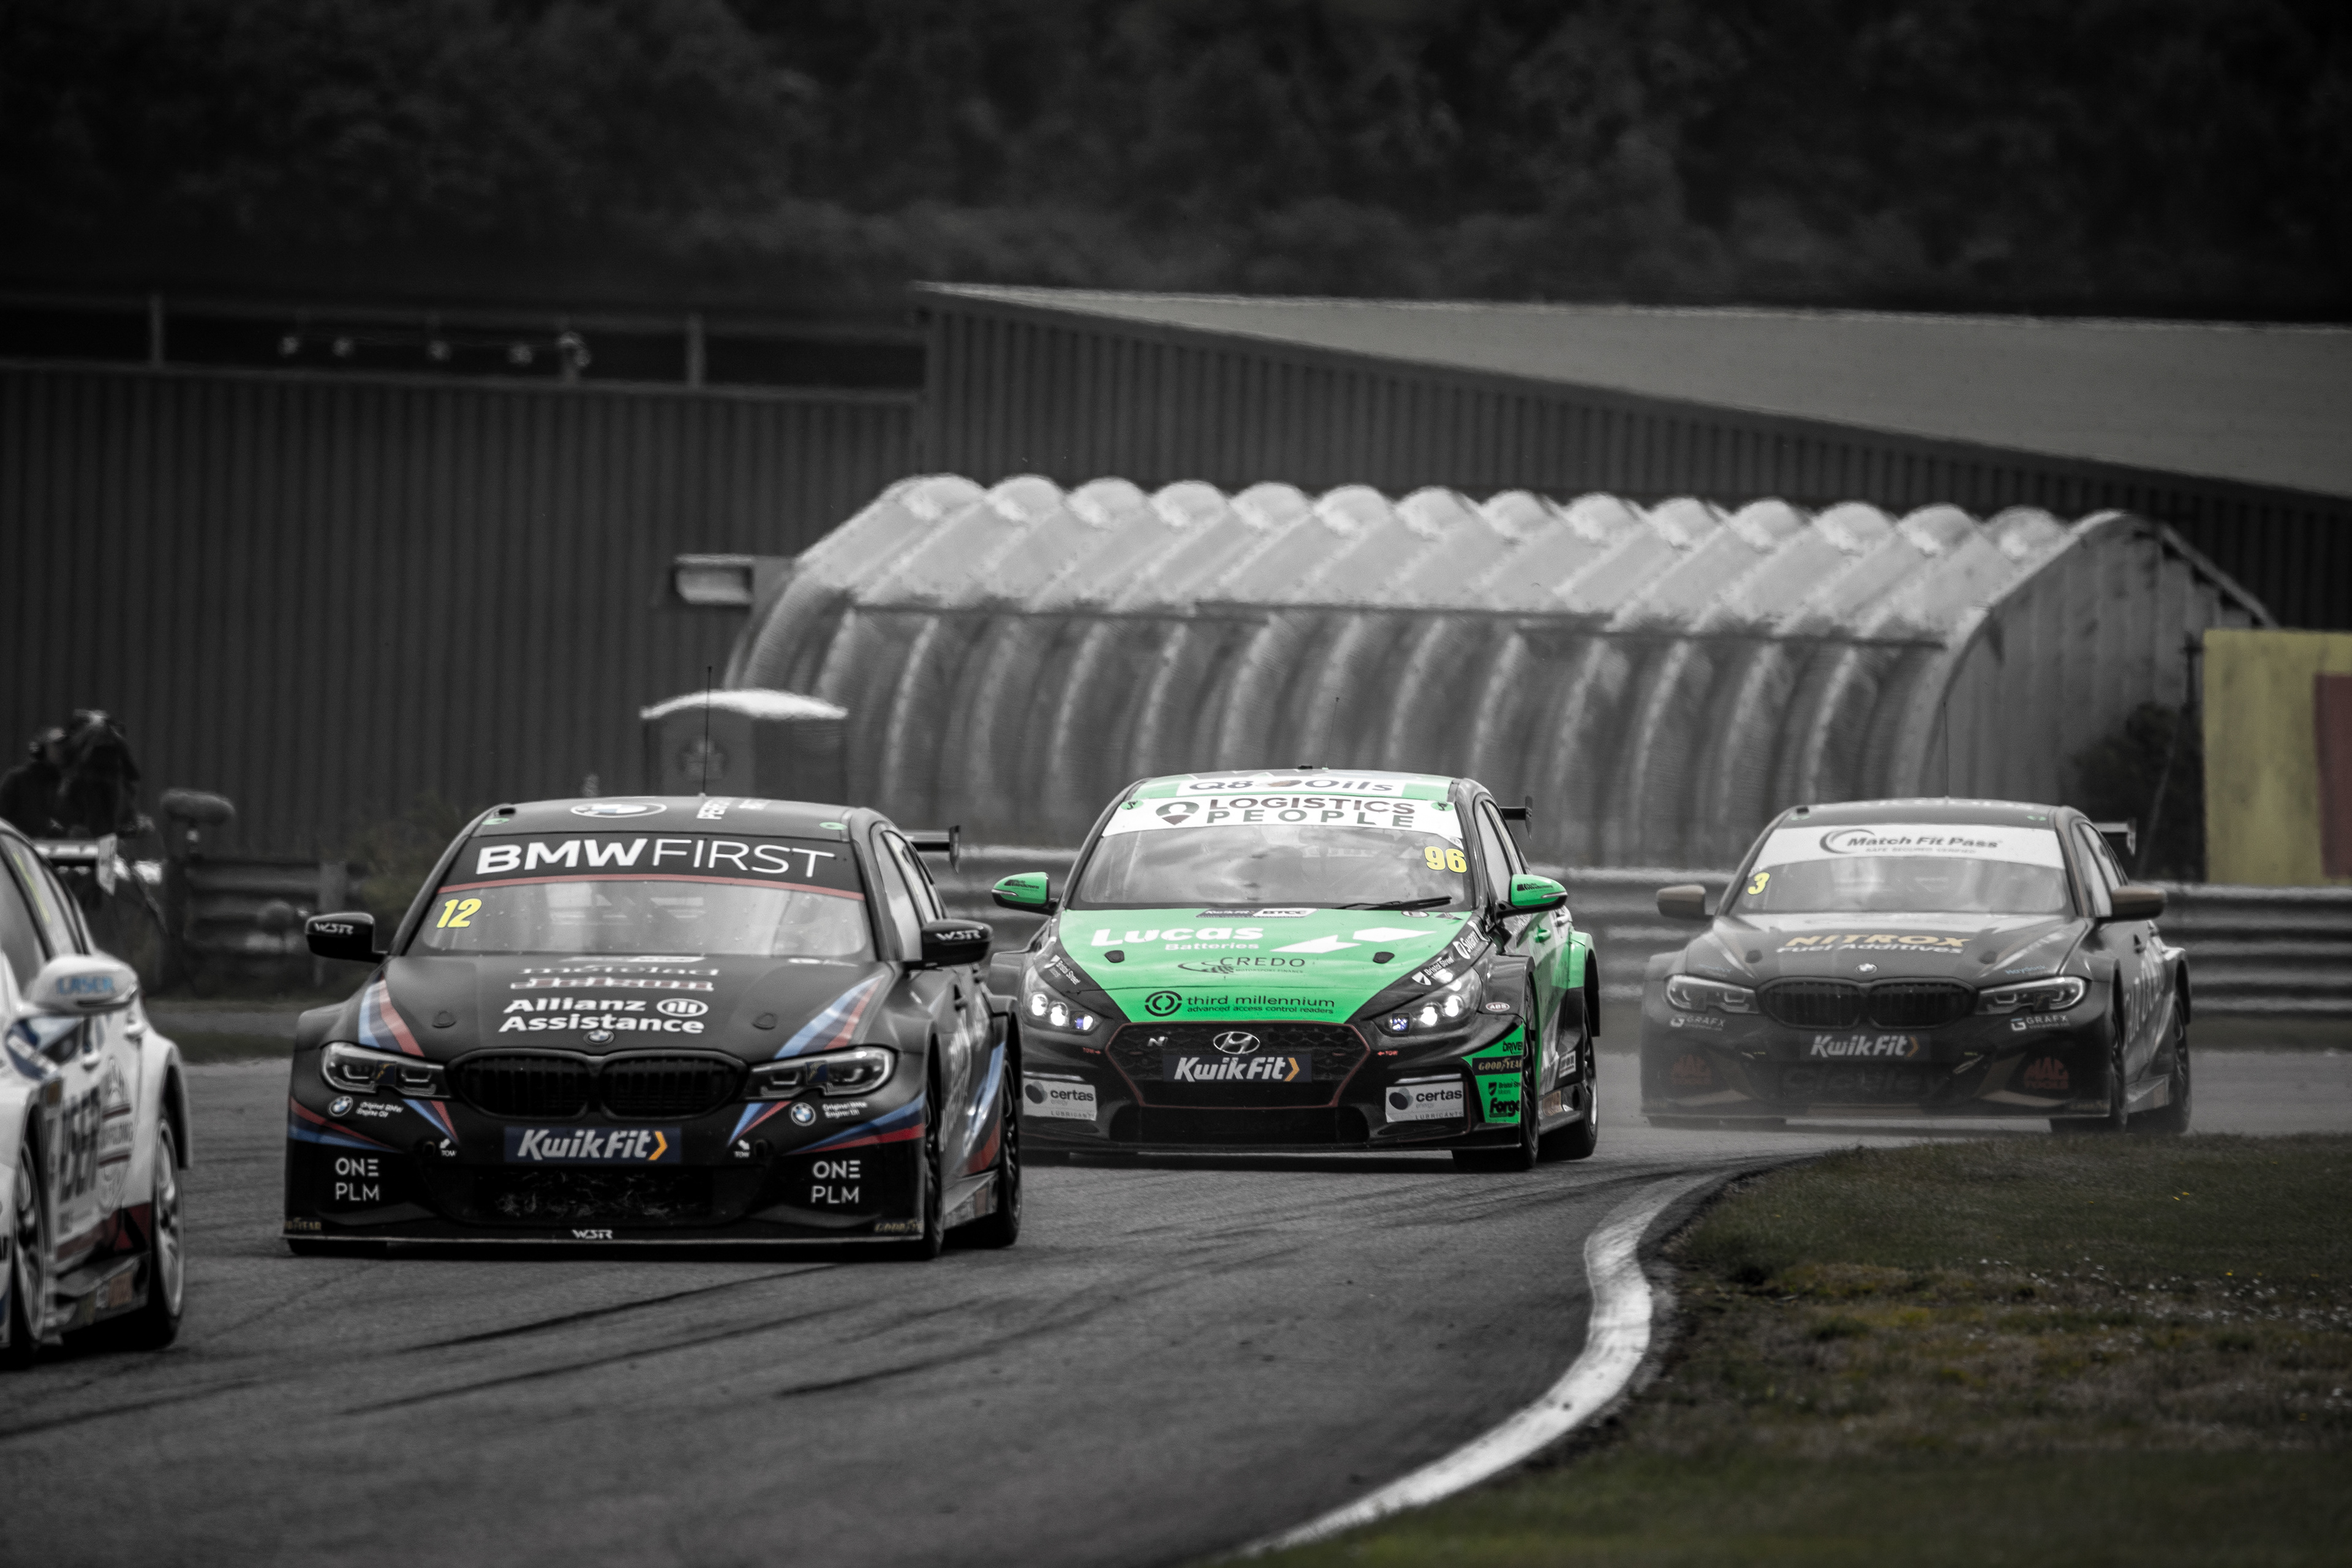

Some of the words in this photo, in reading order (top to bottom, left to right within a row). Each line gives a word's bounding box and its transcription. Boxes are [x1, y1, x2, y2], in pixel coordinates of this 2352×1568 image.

[1189, 780, 1254, 791] Q8
[1305, 780, 1394, 792] Oils
[1209, 797, 1416, 815] LOGISTICS
[1207, 809, 1414, 827] PEOPLE
[1847, 837, 1912, 846] Match
[1915, 837, 1945, 846] Fit
[1948, 837, 1997, 848] Pass
[1423, 845, 1468, 873] 96
[1747, 871, 1771, 895] 3
[435, 898, 483, 929] 12
[935, 929, 981, 941] WSR
[1090, 927, 1264, 946] Lucas
[1460, 930, 1480, 954] Swann
[1785, 934, 1972, 948] NITROX
[1164, 941, 1260, 951] Batteries
[1776, 944, 1834, 953] Fuel
[1838, 943, 1964, 954] Additives
[1220, 956, 1306, 968] CREDO
[502, 997, 647, 1014] Allianz
[1187, 995, 1229, 1005] third
[1235, 995, 1335, 1008] millennium
[1265, 1005, 1297, 1013] control
[1299, 1006, 1333, 1014] readers
[497, 1012, 706, 1035] Assistance
[2026, 1014, 2069, 1025] GRAFX
[1050, 1090, 1095, 1102] certas
[1415, 1090, 1463, 1102] certas
[334, 1156, 381, 1178] ONE
[811, 1159, 861, 1180] ONE
[334, 1181, 381, 1202] PLM
[810, 1185, 860, 1204] PLM
[570, 1229, 613, 1239] WSR
